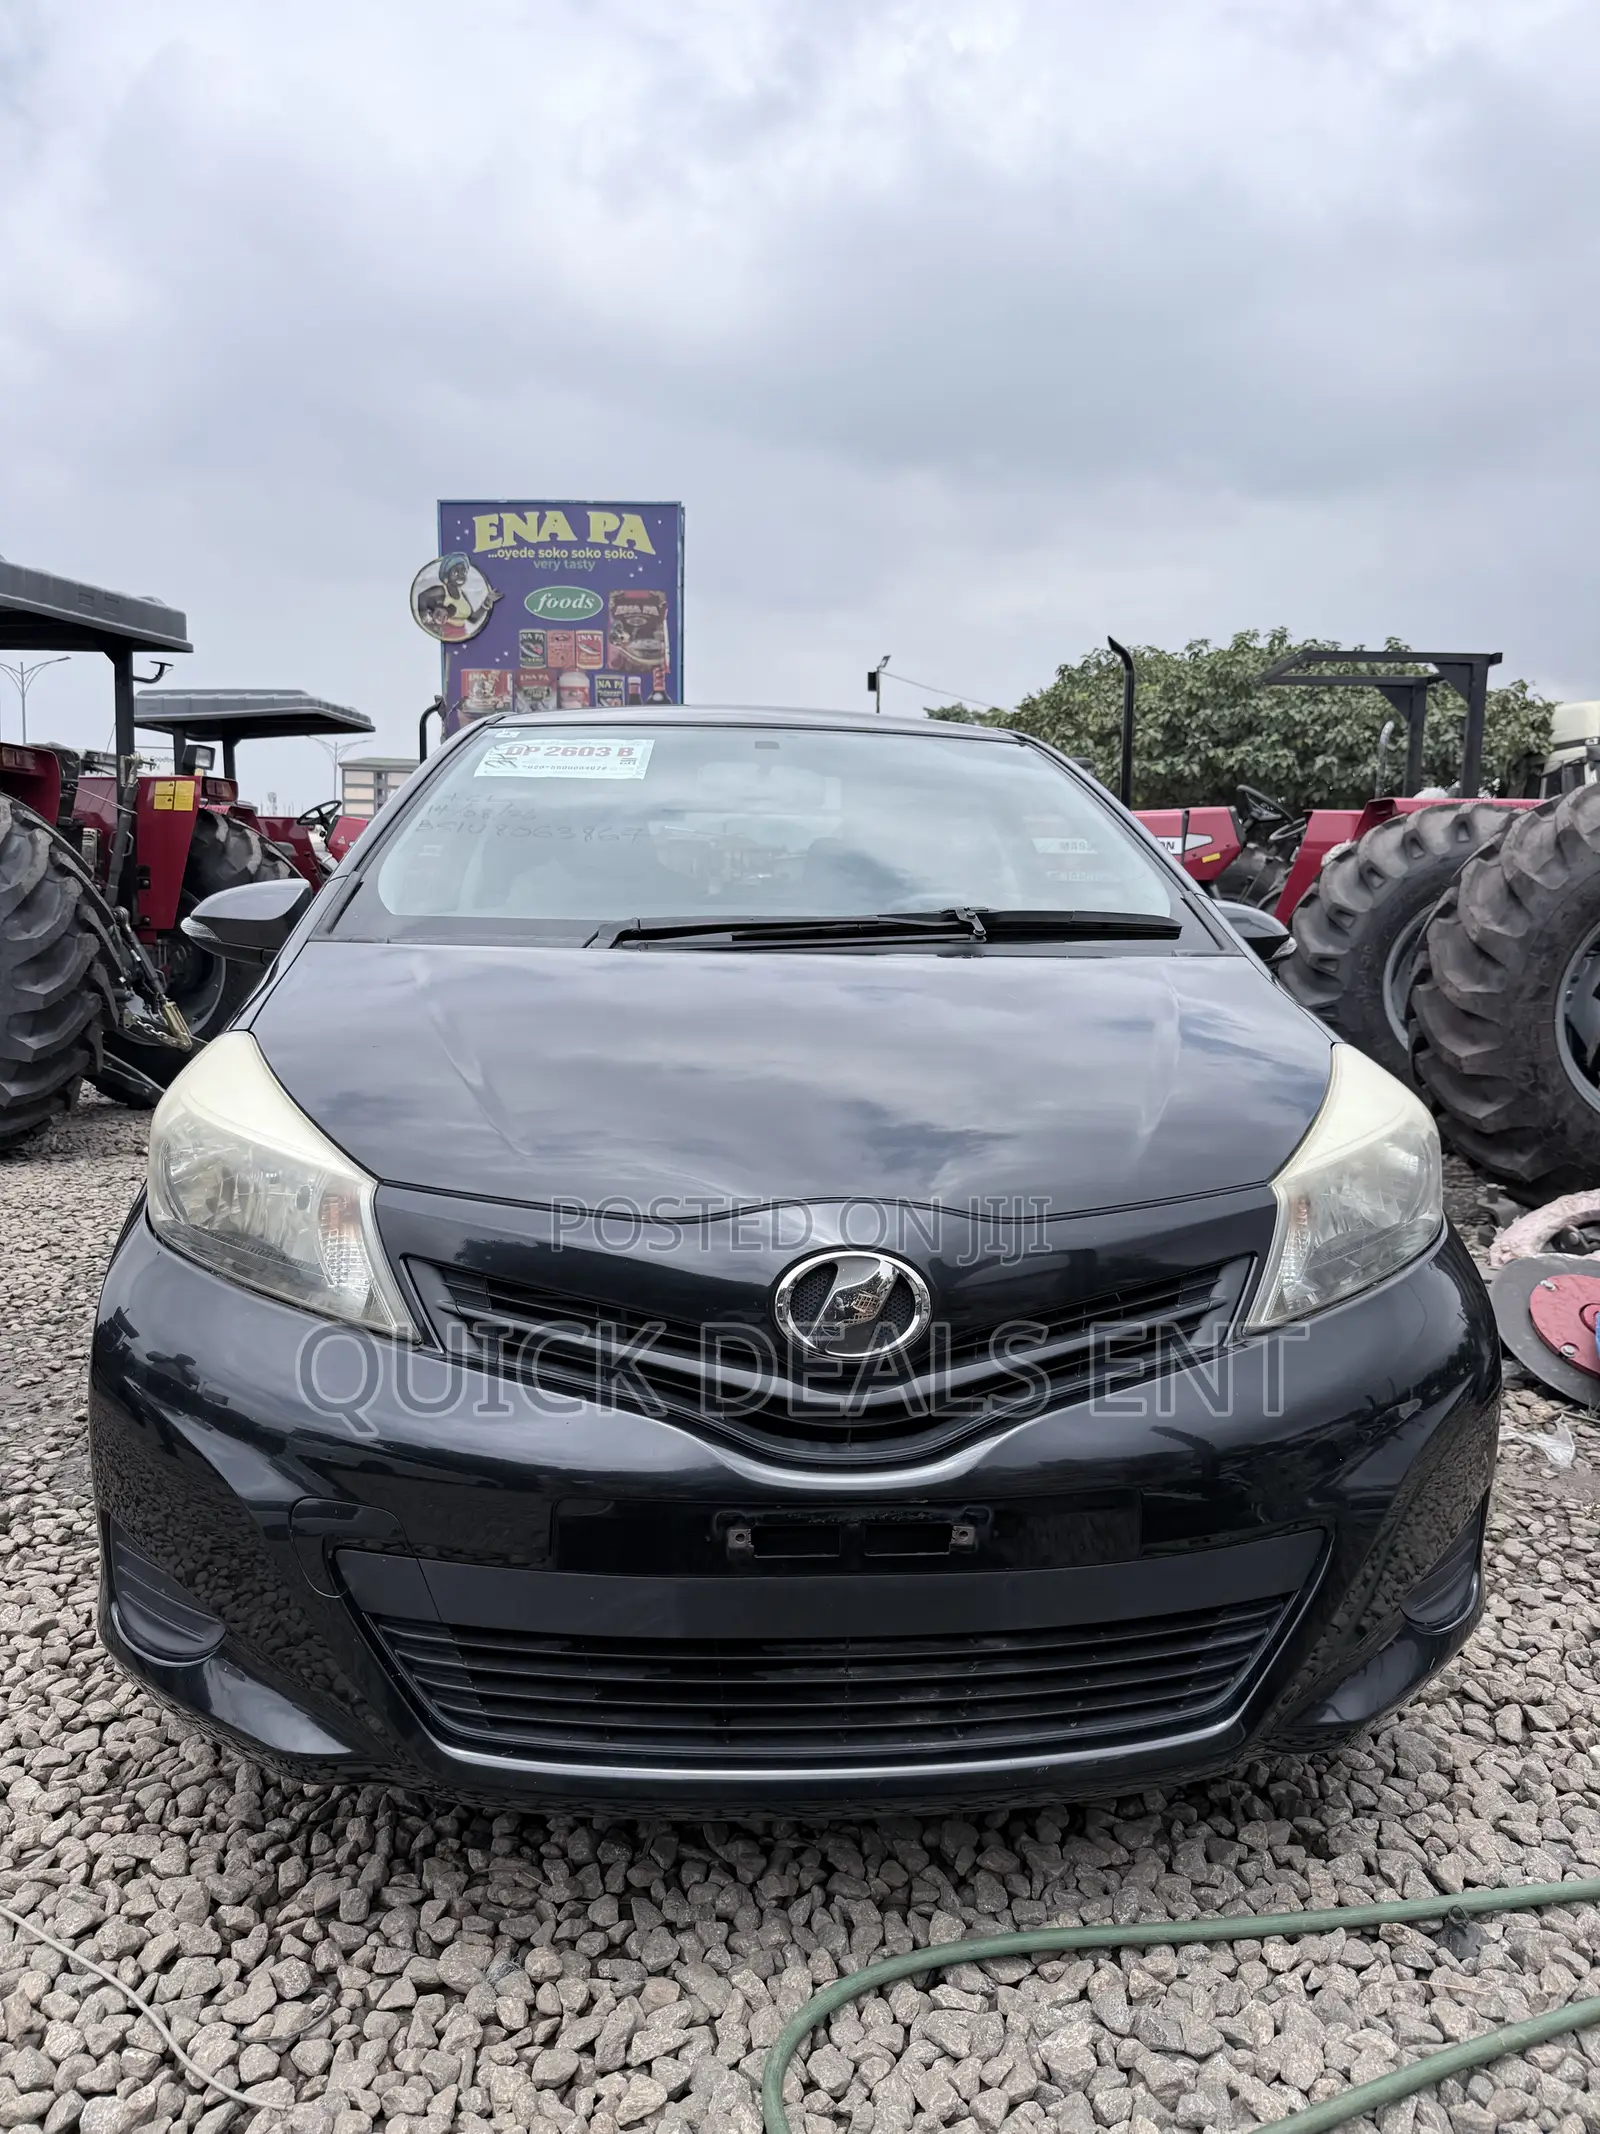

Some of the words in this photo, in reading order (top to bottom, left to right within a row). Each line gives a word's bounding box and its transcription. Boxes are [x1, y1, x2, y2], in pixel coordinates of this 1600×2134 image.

[472, 511, 578, 553] ENA
[586, 511, 656, 555] PA
[538, 548, 568, 559] soko
[571, 548, 601, 559] soko
[533, 560, 561, 571] very
[564, 559, 596, 571] tasty
[534, 593, 594, 612] foods
[543, 746, 612, 757] 2603
[617, 747, 635, 757] B
